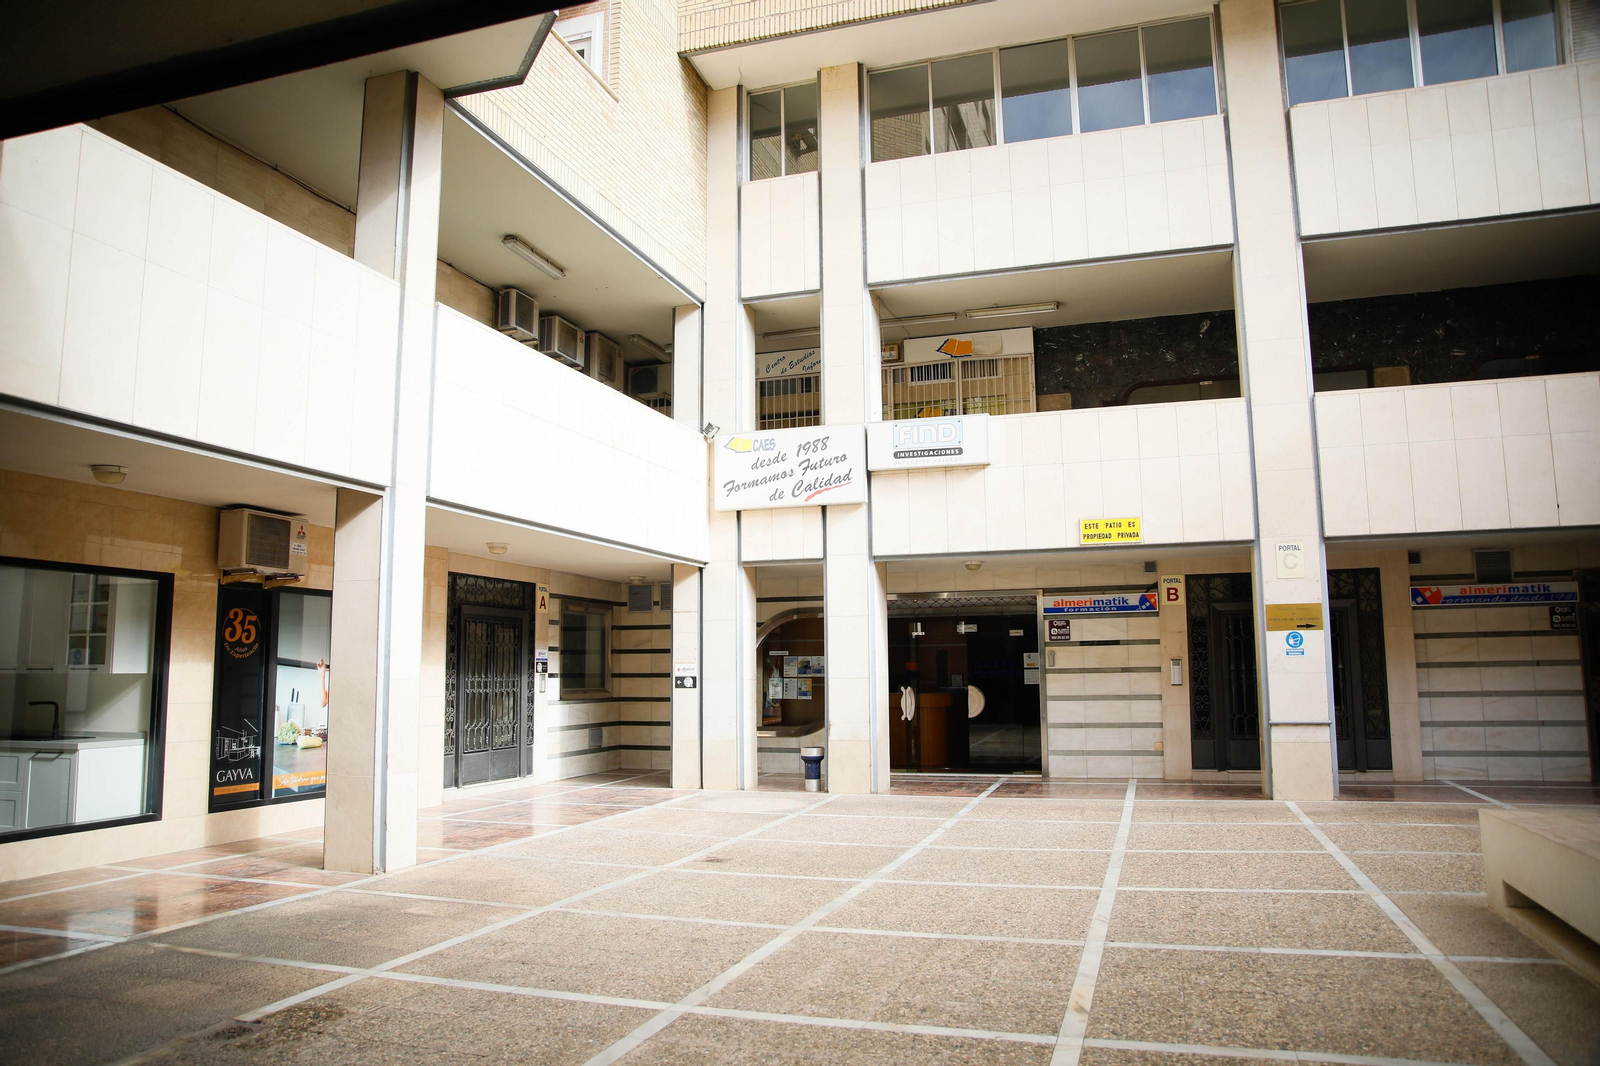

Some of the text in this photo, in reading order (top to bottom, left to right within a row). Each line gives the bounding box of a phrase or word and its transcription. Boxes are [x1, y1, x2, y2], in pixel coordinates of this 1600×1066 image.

[765, 356, 786, 373] Centro
[788, 350, 815, 369] Estudios
[802, 360, 821, 372] Infor
[898, 423, 957, 445] FIND
[752, 438, 776, 452] CAES
[751, 436, 830, 470] desde 1988
[897, 449, 960, 458] INVESTIGACIONES
[723, 453, 848, 497] Formamos Futuro
[769, 468, 853, 502] de Calidad
[1282, 553, 1298, 570] C
[1167, 587, 1179, 601] B
[1460, 584, 1551, 595] almerimatik
[540, 596, 547, 609] A
[1053, 597, 1129, 607] almerimatik
[1510, 594, 1546, 602] desde
[225, 608, 257, 644] 35
[216, 768, 253, 783] GAYVA
